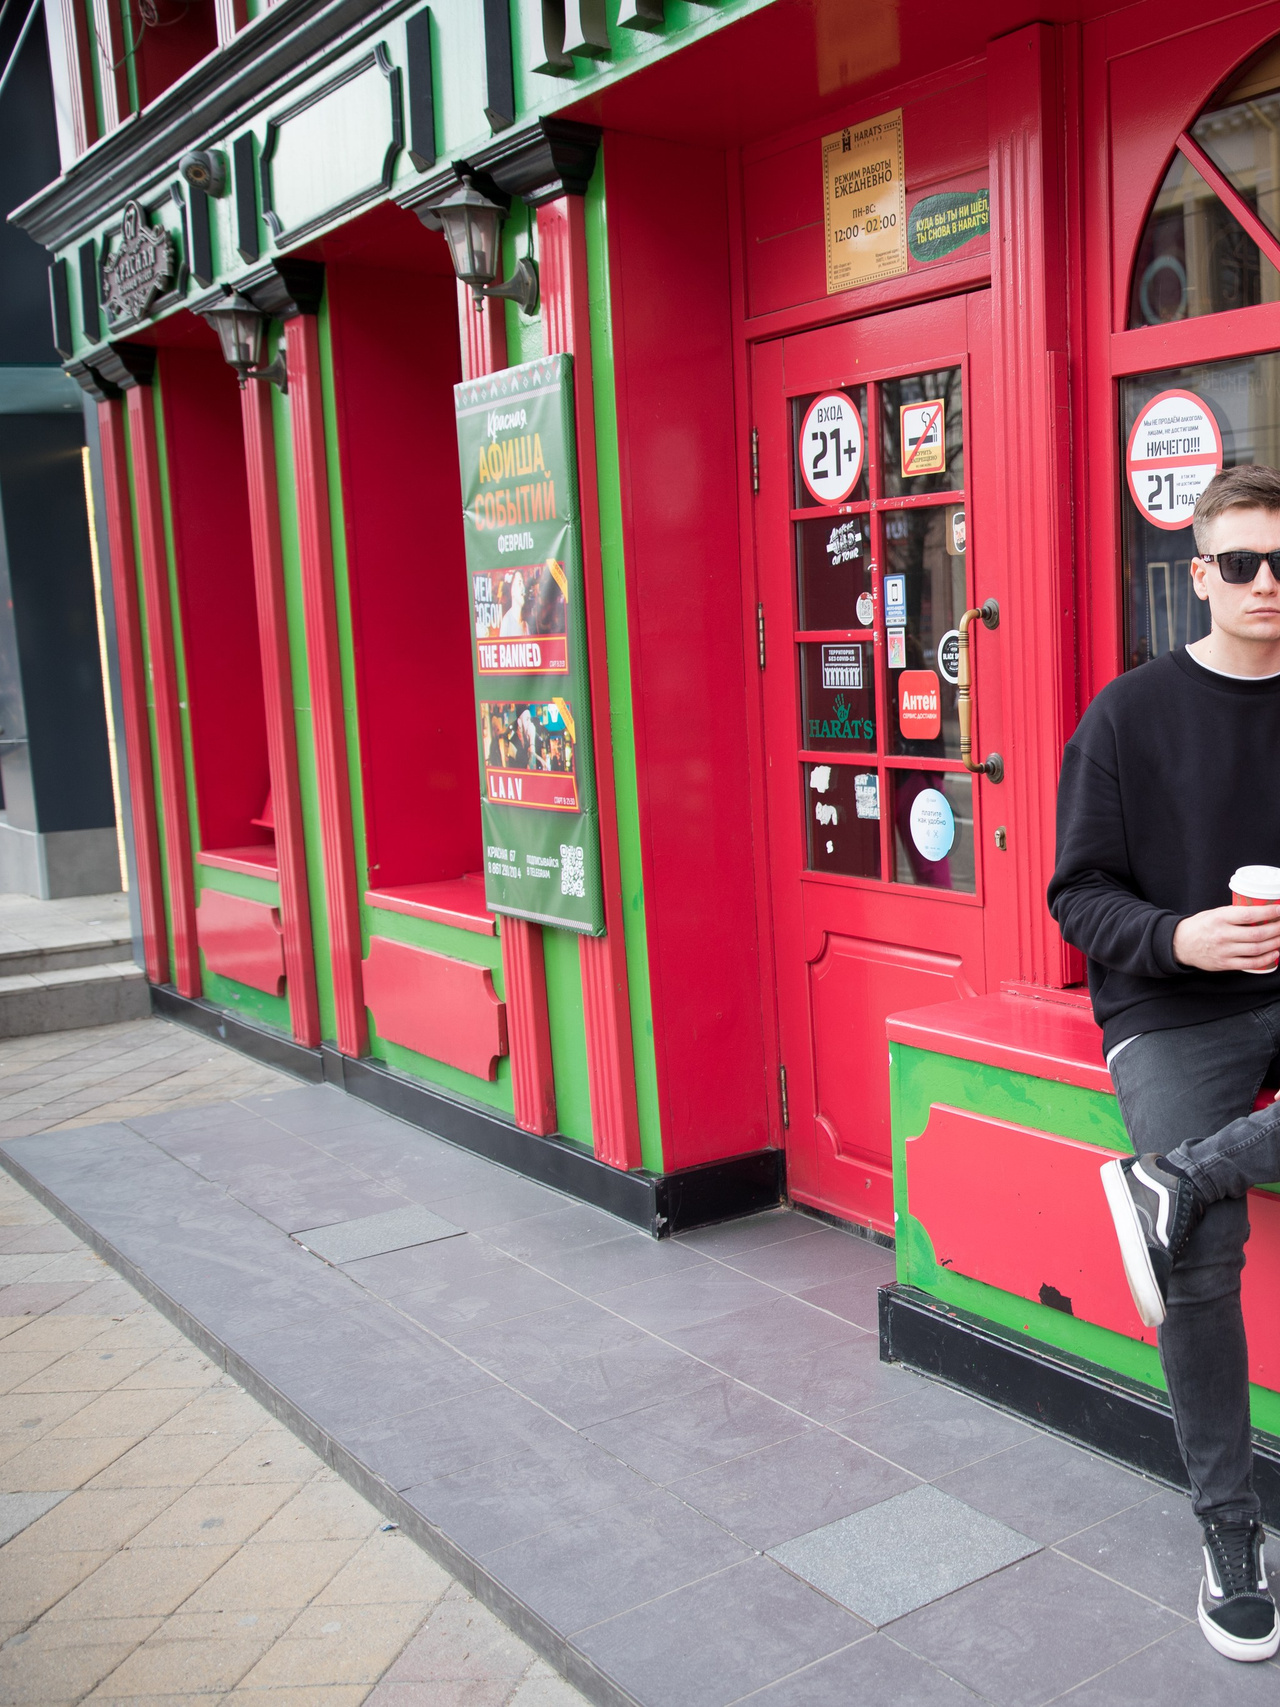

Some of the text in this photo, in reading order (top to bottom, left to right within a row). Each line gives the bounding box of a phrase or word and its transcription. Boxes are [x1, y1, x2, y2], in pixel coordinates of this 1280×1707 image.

[854, 125, 883, 142] HARAT'S
[834, 158, 892, 186] РЕЖИМ РАБОТЫ
[834, 169, 893, 199] ЕЖЕДНЕВНО
[853, 203, 877, 219] ПН-ВС:
[916, 216, 934, 232] КУДА
[935, 212, 946, 226] БЫ
[947, 208, 958, 222] ТЫ
[959, 204, 969, 219] НИ
[834, 224, 860, 243] 12:00
[916, 231, 927, 245] ТЫ
[928, 224, 951, 241] СНОВА
[951, 222, 957, 234] В
[487, 408, 528, 443] Красная
[817, 405, 844, 423] ВХОД
[479, 432, 545, 483] АФИША
[812, 427, 857, 480] 21+
[1146, 436, 1201, 458] НИЧЕГО!!!
[474, 470, 557, 532] СОБЫТИЙ
[1147, 473, 1174, 511] 21
[497, 531, 534, 554] ФЕВРАЛЬ
[478, 642, 541, 669] THE BANNED
[902, 690, 937, 711] Антей
[808, 717, 874, 740] HARAT'S
[490, 774, 523, 801] LAAV
